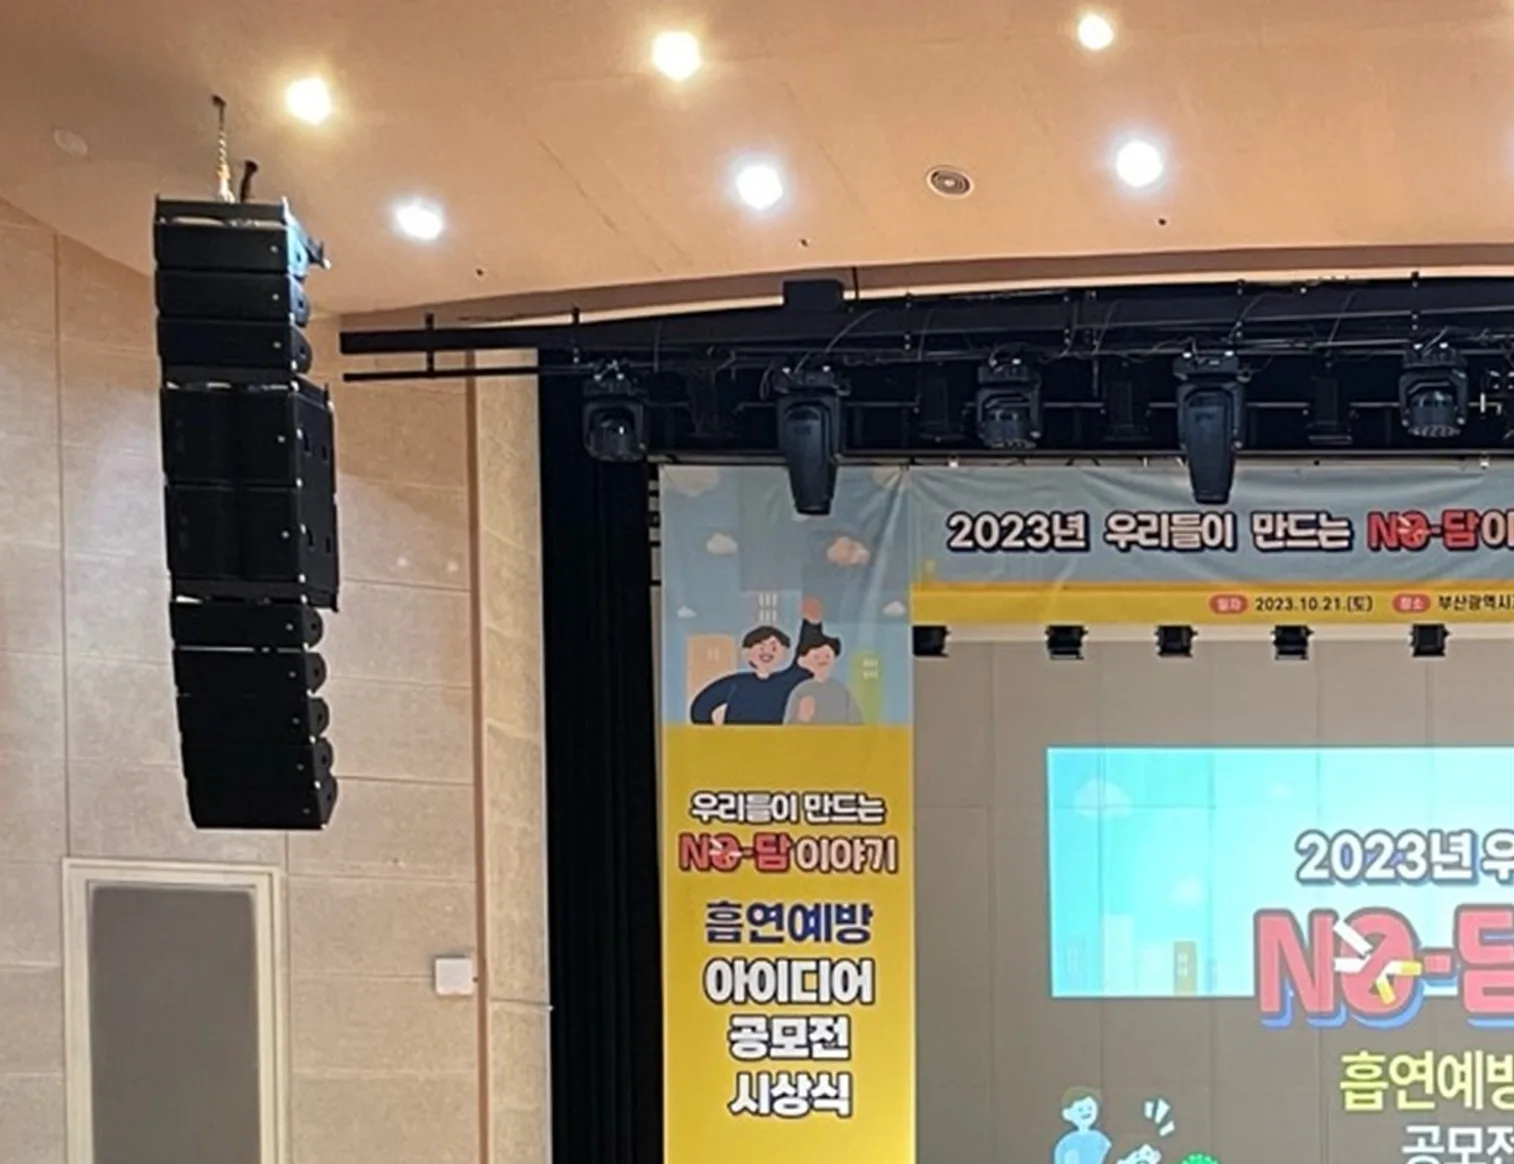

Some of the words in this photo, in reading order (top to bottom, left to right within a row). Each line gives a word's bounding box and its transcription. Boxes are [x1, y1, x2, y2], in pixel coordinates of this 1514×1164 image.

[947, 510, 1089, 553] 2023년
[1104, 510, 1238, 552] 우리들이
[1252, 510, 1354, 553] 만드는
[690, 790, 799, 826] 우리들이
[802, 791, 886, 825] 만드는
[1297, 829, 1473, 884] 2023년
[703, 956, 875, 1004] 아이디어
[727, 1014, 851, 1061] 공모전
[727, 1071, 852, 1118] 시상식
